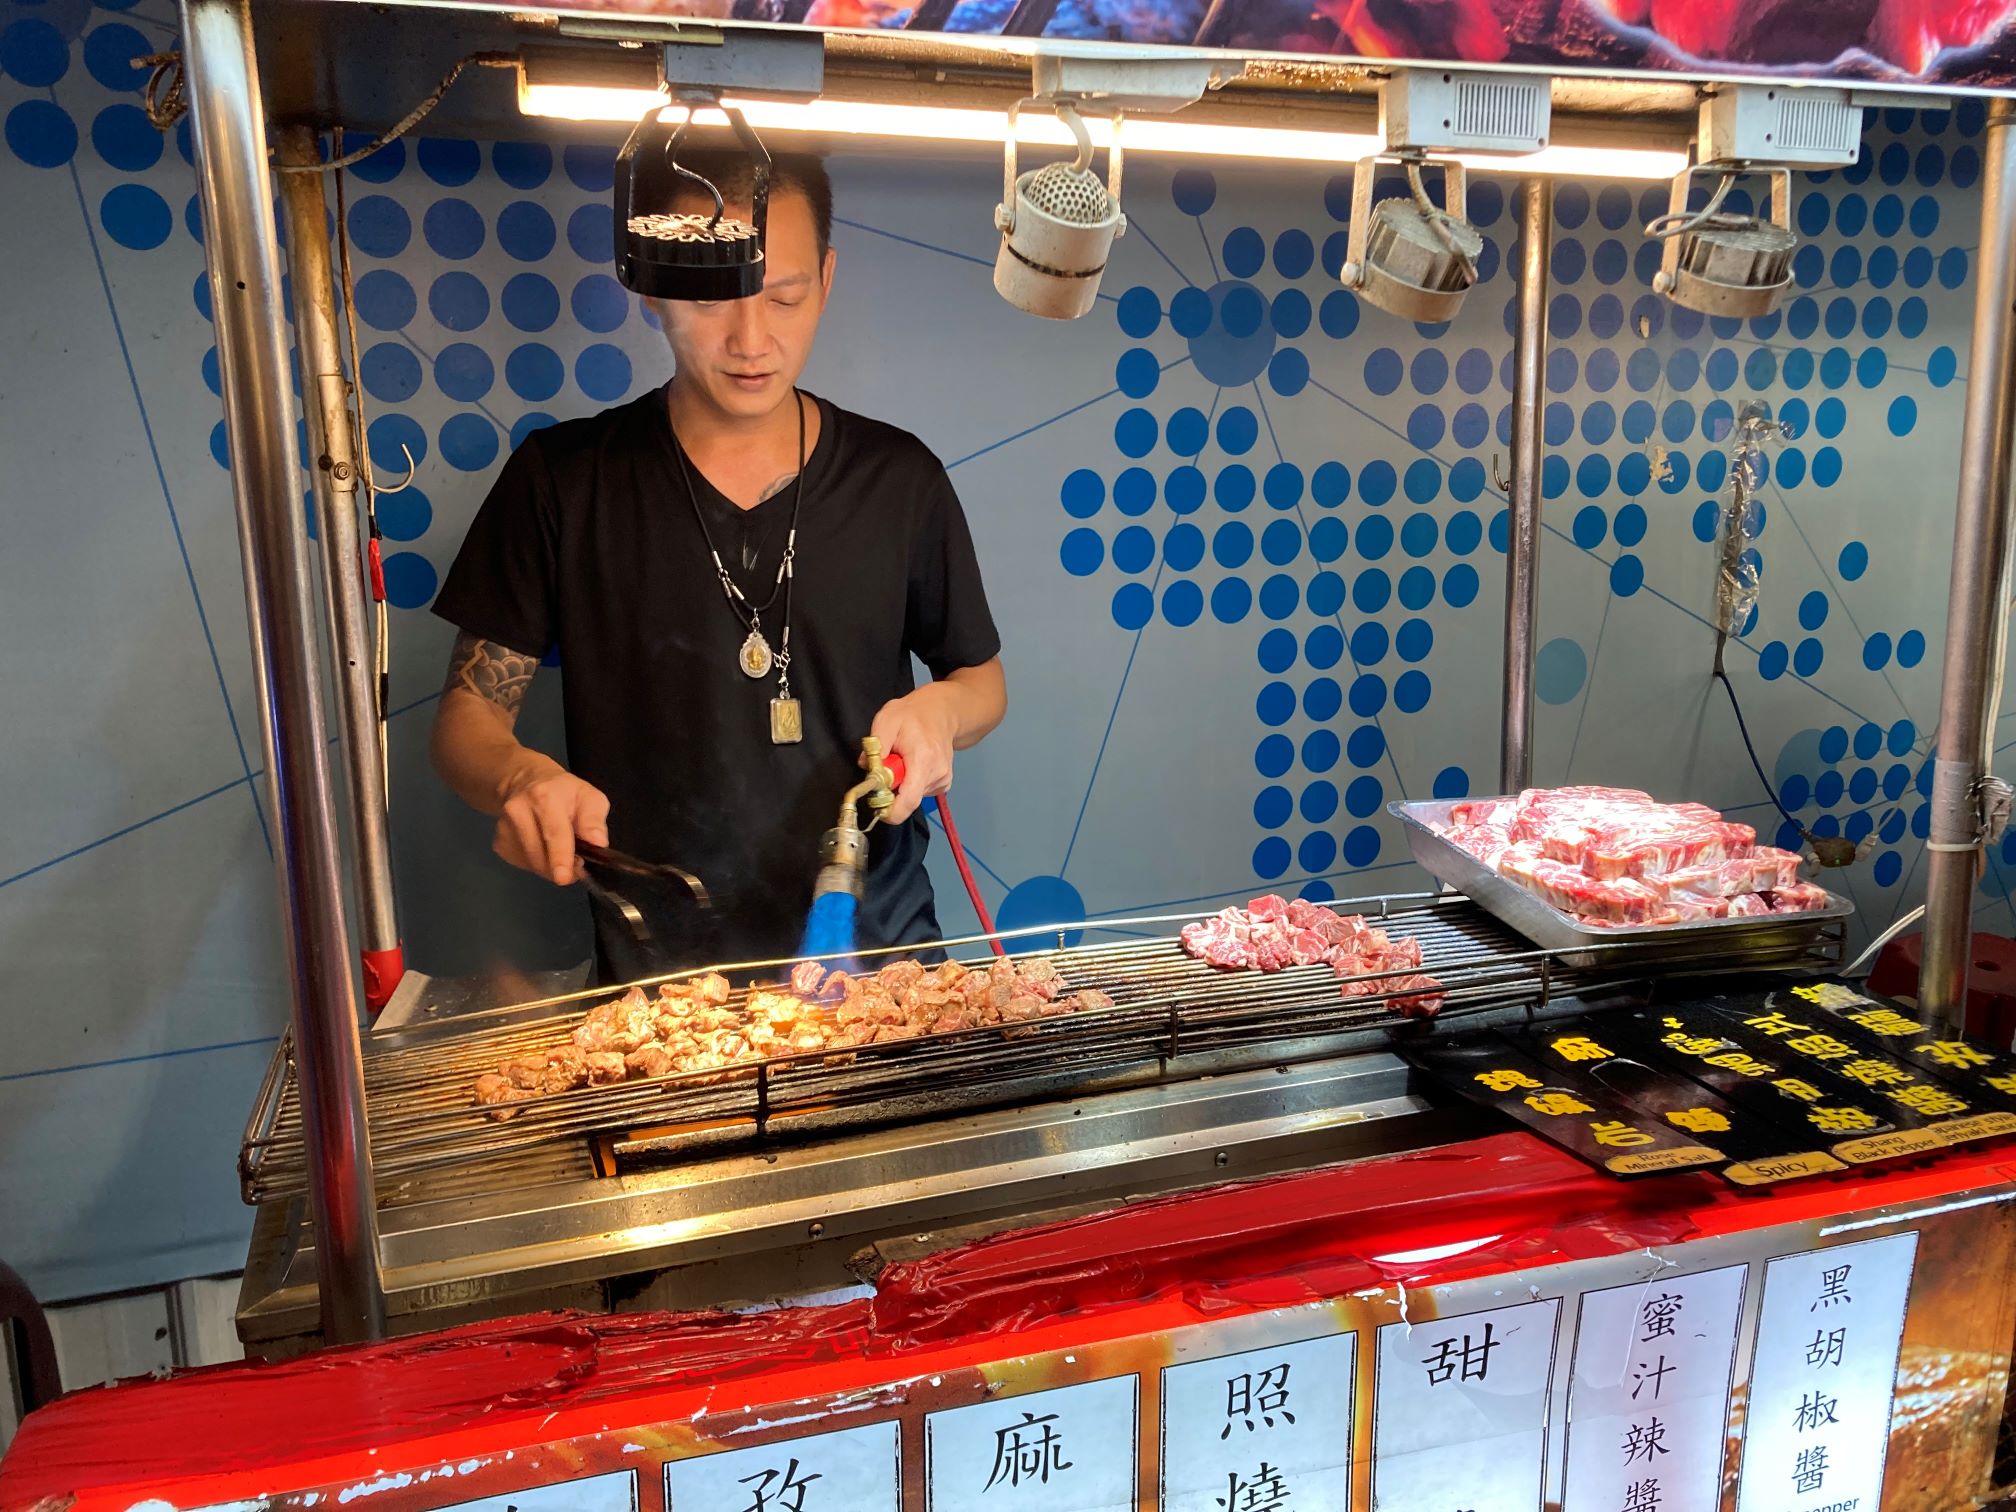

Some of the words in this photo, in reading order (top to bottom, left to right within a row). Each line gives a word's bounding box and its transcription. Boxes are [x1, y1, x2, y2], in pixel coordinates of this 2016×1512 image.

[1935, 1120, 1981, 1134] apanese
[1639, 1152, 1676, 1162] Rose
[1852, 1147, 1890, 1161] Black
[1893, 1140, 1936, 1153] pepper
[1624, 1159, 1677, 1171] Mineral
[1680, 1153, 1711, 1163] Salt
[1755, 1161, 1809, 1178] Spicy
[1421, 1321, 1502, 1387] 甜
[1792, 1264, 1852, 1495] 黑胡椒醬
[1621, 1292, 1685, 1512] 蜜汁辣醬
[981, 1411, 1074, 1494] 麻
